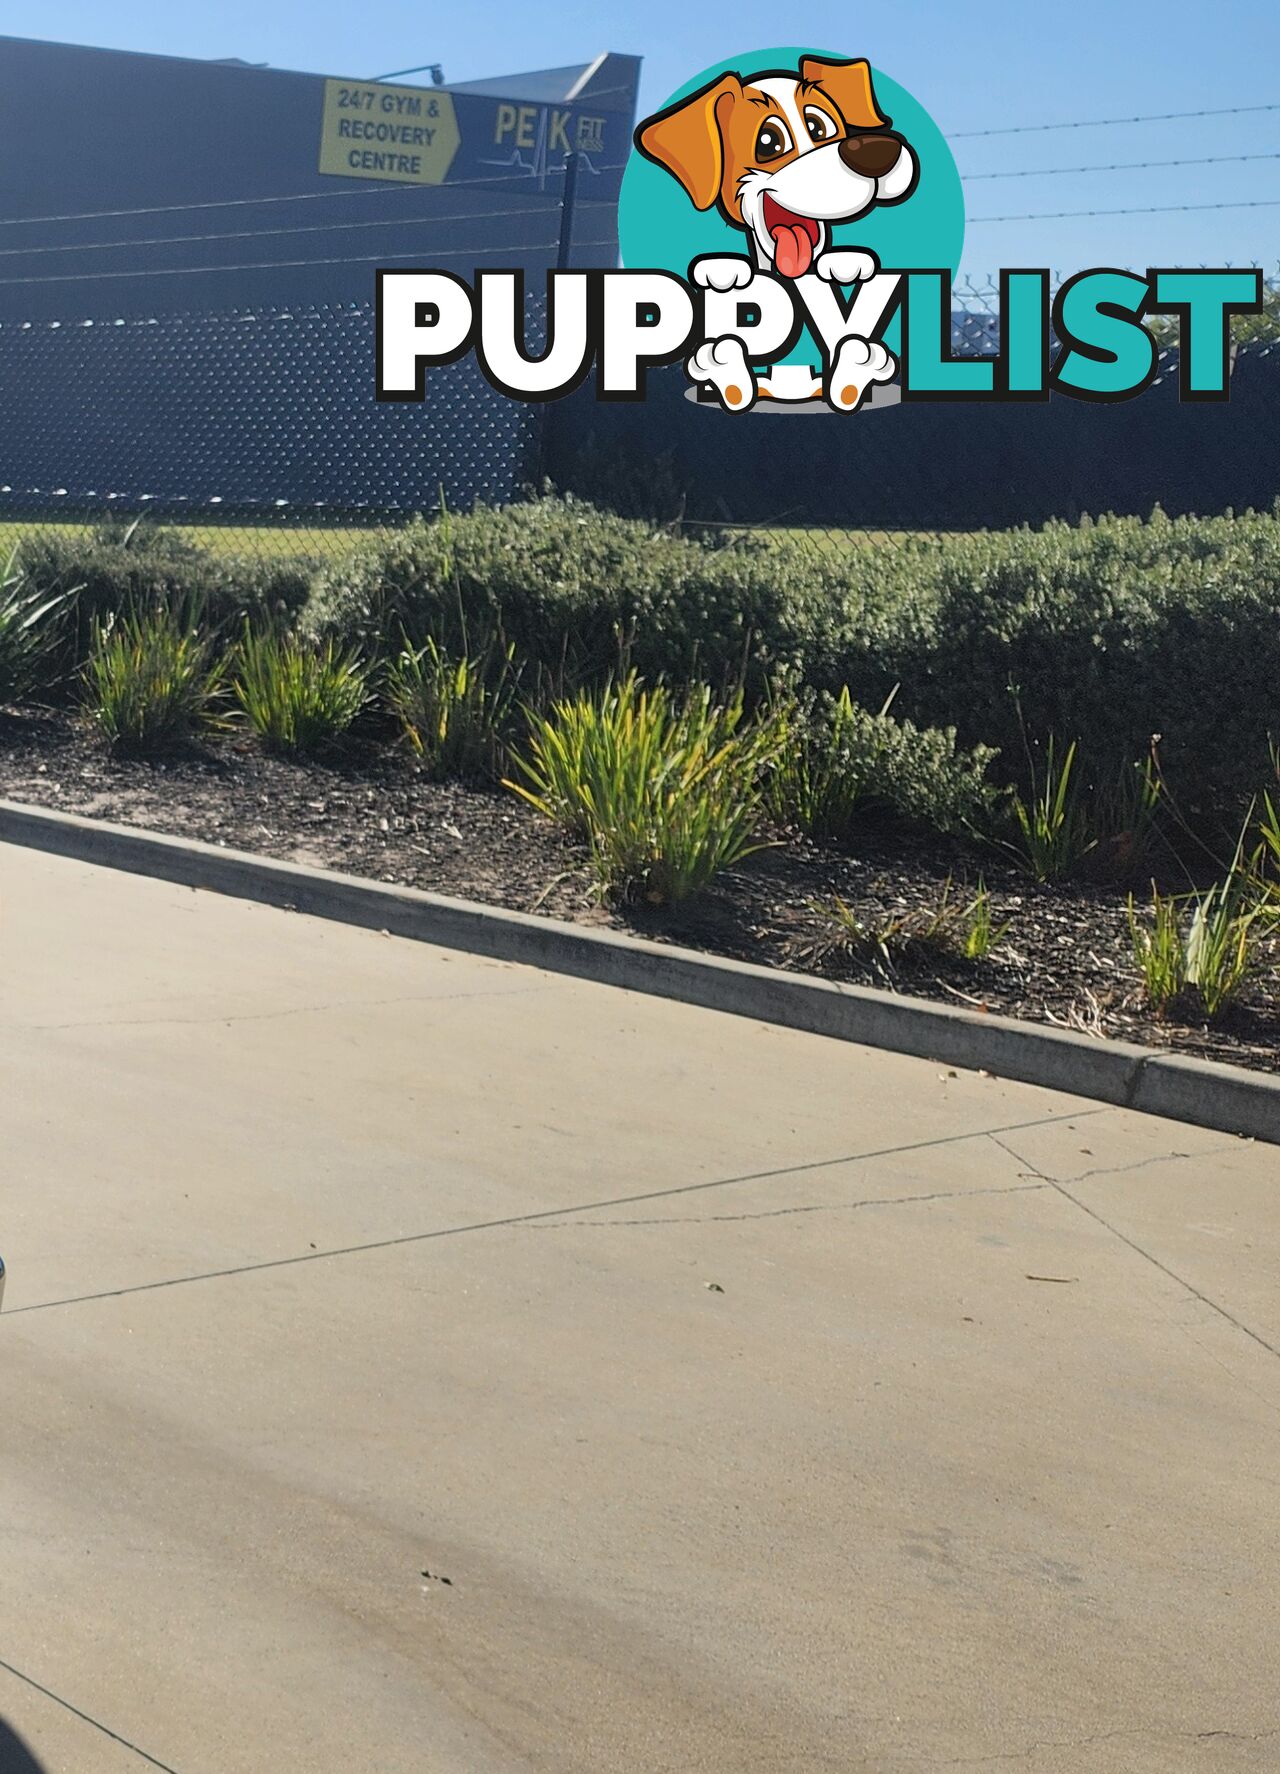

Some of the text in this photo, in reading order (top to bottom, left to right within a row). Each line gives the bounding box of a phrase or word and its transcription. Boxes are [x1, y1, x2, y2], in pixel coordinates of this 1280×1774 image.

[338, 89, 440, 118] 24/7 GYM &
[338, 118, 436, 147] RECOVERY
[577, 115, 607, 141] FIT
[348, 149, 421, 175] CENTRE
